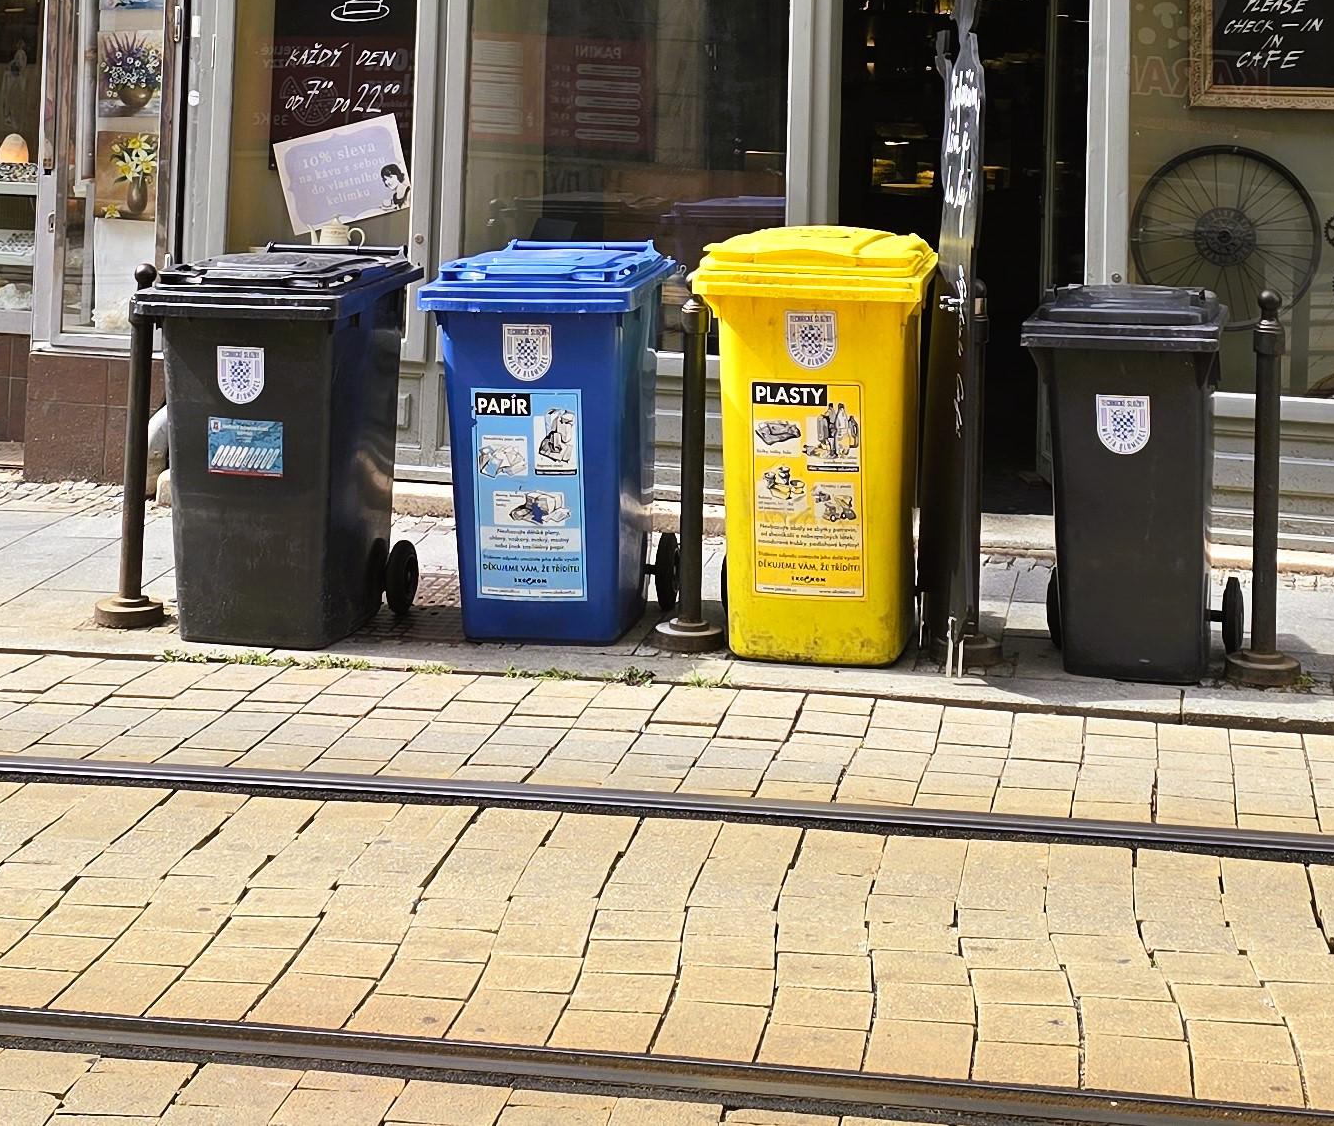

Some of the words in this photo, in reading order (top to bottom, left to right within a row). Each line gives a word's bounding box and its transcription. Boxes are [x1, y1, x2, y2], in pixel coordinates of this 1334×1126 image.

[1261, 34, 1284, 50] IN
[285, 42, 350, 67] KAŽDÝ
[355, 50, 397, 67] DEN
[1236, 50, 1305, 69] CAFE
[302, 150, 332, 169] 10%
[337, 142, 377, 161] sleva
[353, 156, 387, 170] sebou
[311, 185, 325, 195] do
[326, 171, 380, 190] vlastního
[326, 188, 371, 206] kelímku
[477, 394, 528, 415] PAPÍR
[755, 385, 824, 405] PLASTY
[758, 559, 796, 569] DĚKUJEME
